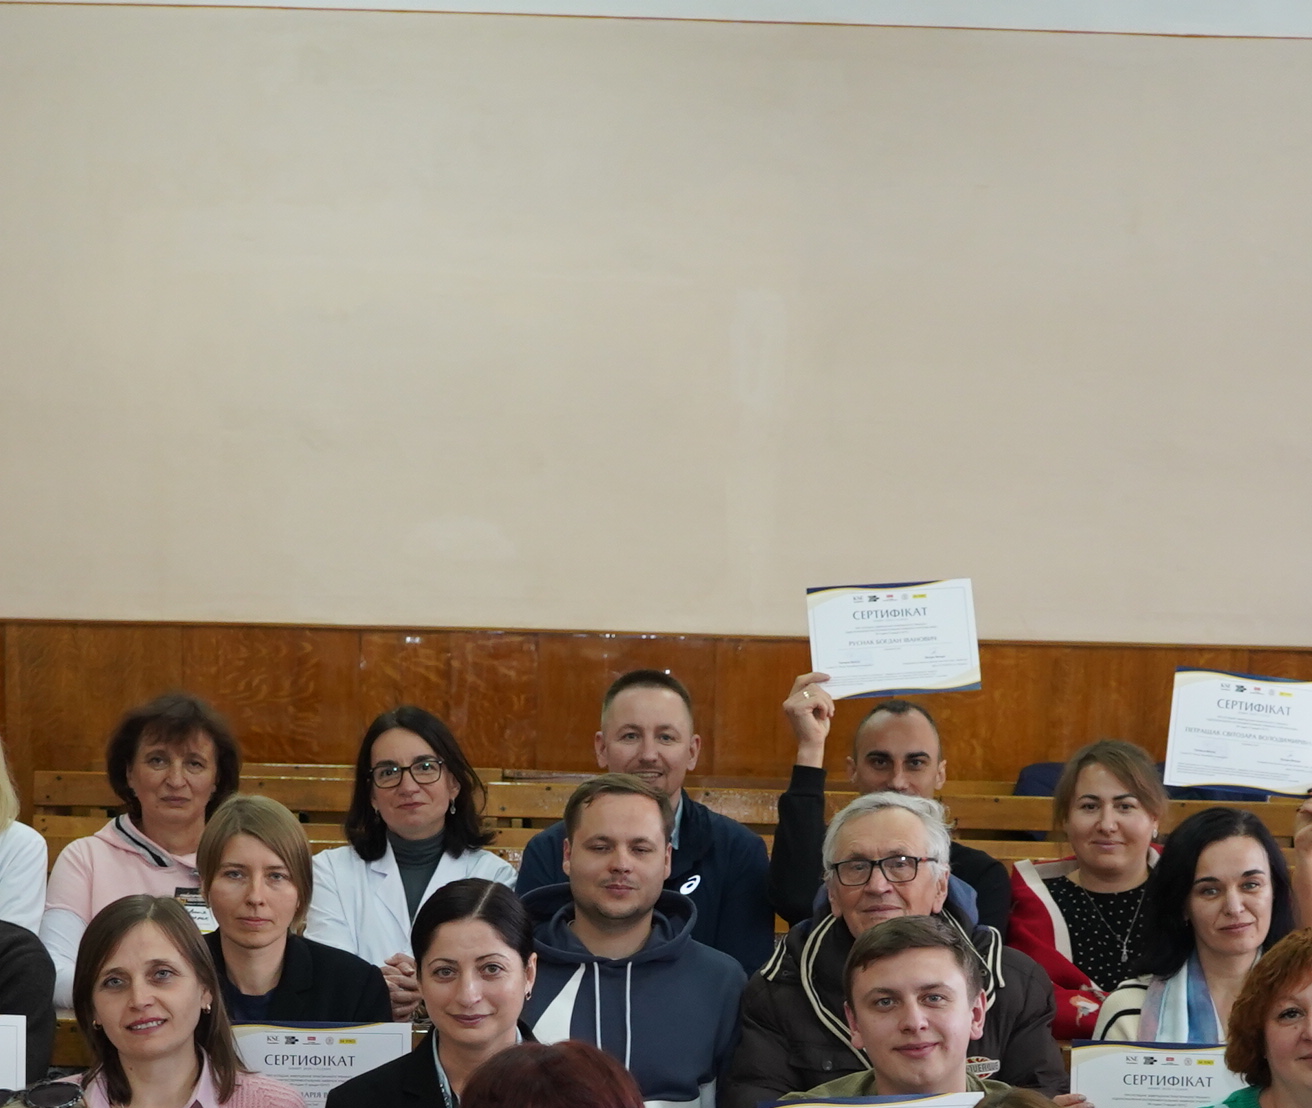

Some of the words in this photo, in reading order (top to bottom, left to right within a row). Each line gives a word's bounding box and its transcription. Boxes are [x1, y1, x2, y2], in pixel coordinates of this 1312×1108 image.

[853, 607, 927, 621] СЕРТИФІКАТ
[1217, 698, 1291, 716] СЕРТИФІКАТ
[265, 1054, 355, 1067] СЕРТИФІКАТ
[1123, 1074, 1213, 1088] СЕРТИФІКАТ
